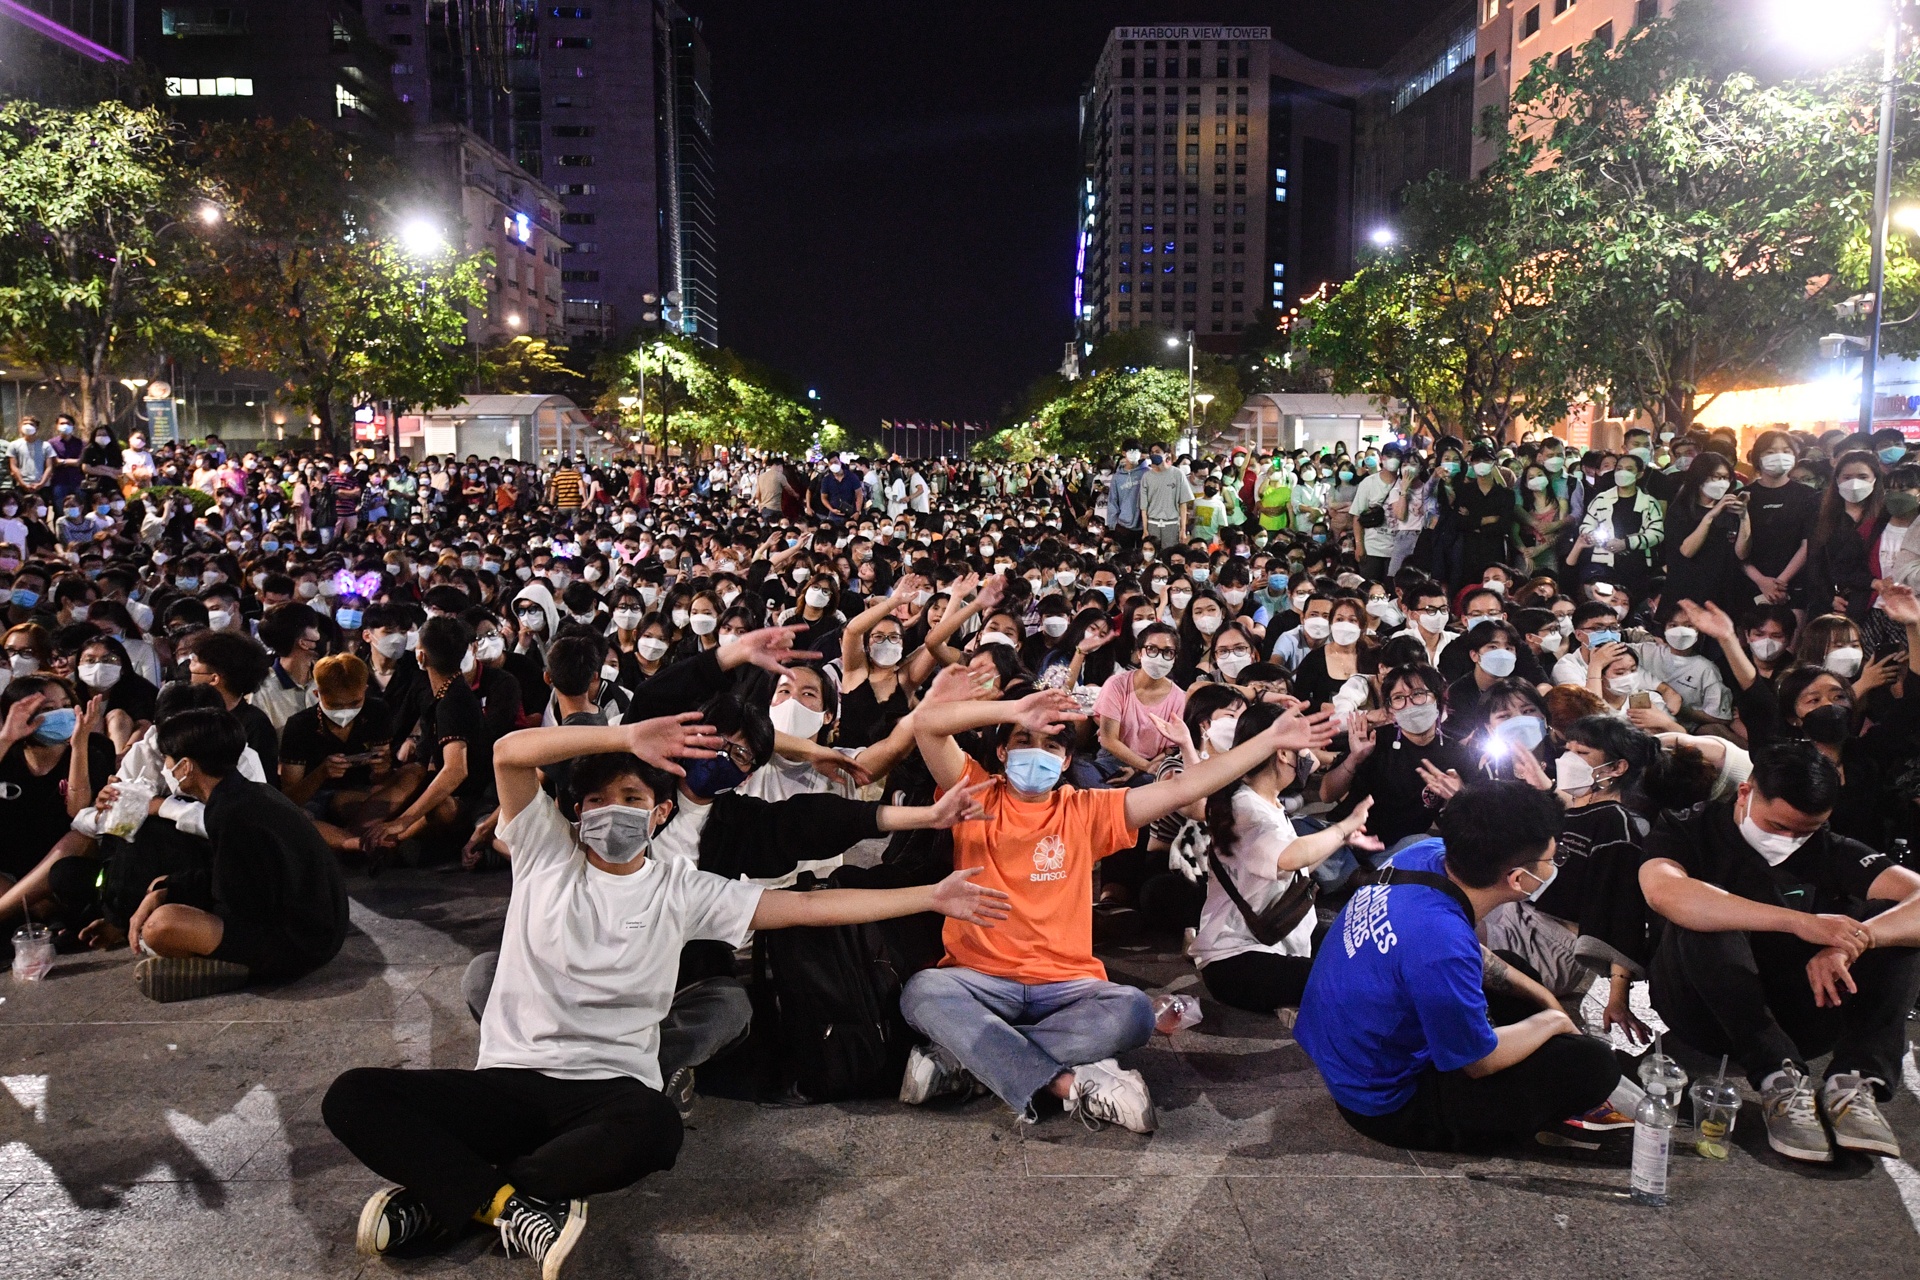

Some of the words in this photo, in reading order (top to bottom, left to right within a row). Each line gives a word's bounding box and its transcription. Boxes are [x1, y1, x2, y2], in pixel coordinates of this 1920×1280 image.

[1132, 27, 1189, 39] HARBOUR
[1192, 27, 1222, 39] VIEW
[1225, 27, 1268, 39] TOWER
